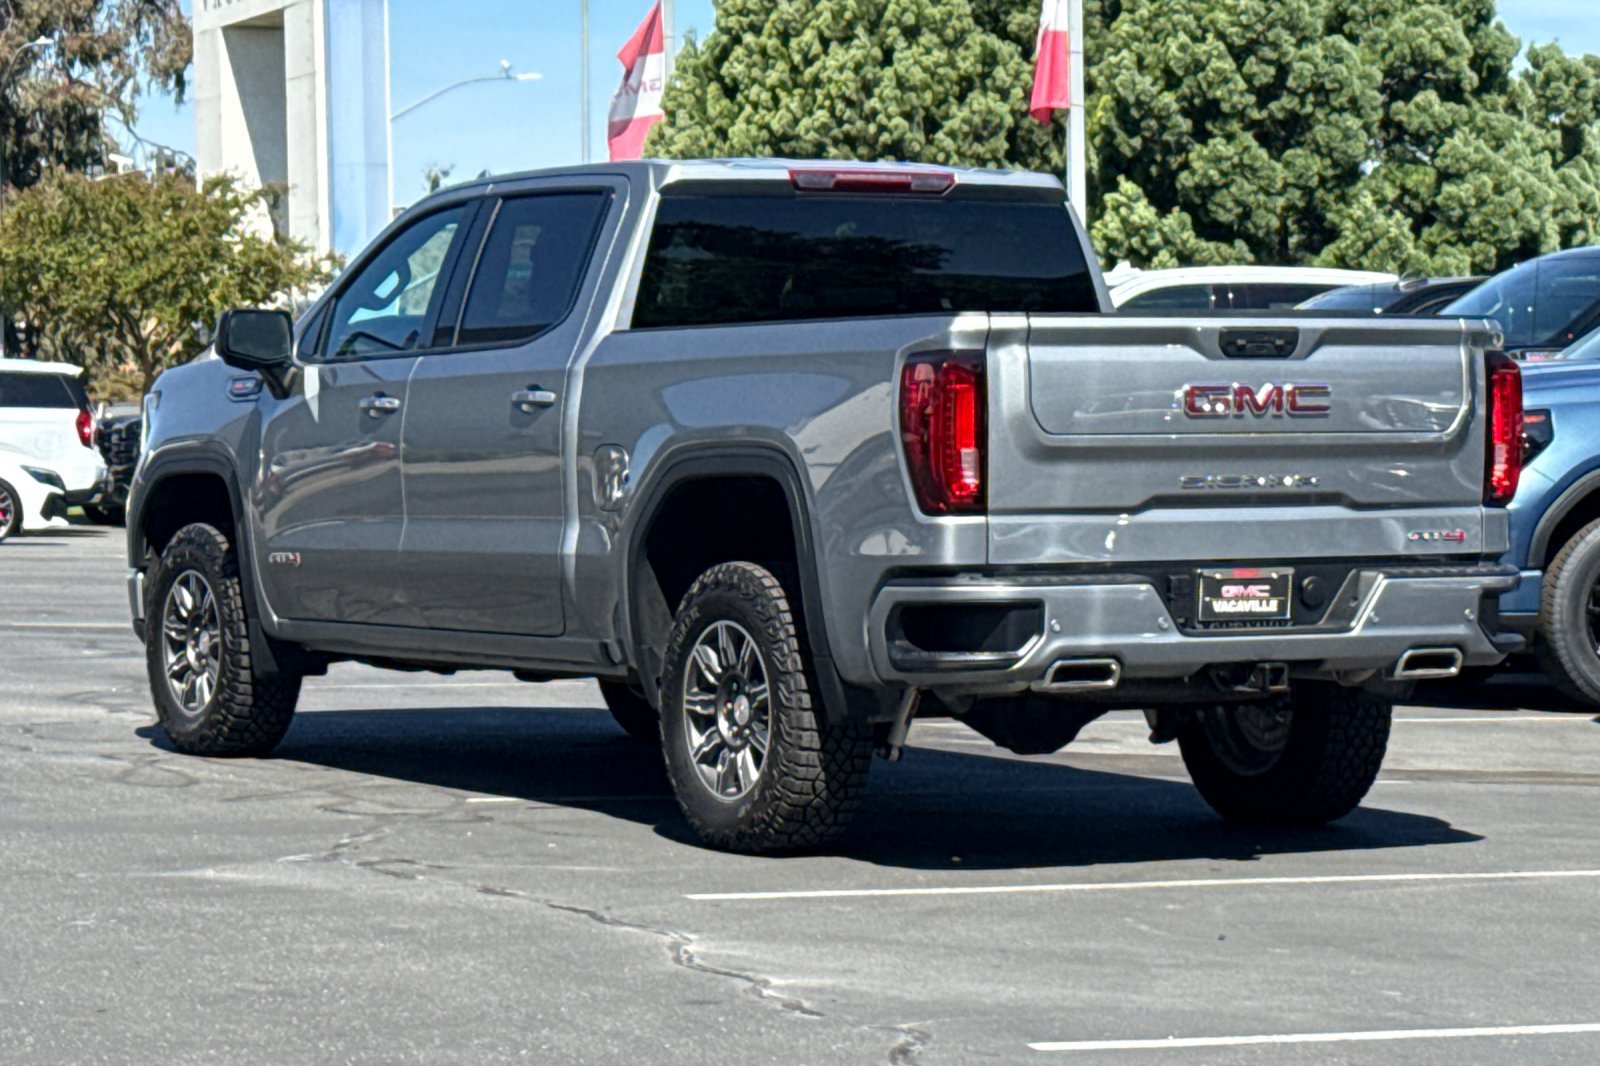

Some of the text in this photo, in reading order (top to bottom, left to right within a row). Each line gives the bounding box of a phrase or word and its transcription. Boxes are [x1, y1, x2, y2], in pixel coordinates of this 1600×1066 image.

[1183, 383, 1332, 419] GMC
[1221, 585, 1271, 597] GMC
[1212, 599, 1279, 613] VACAVILLE
